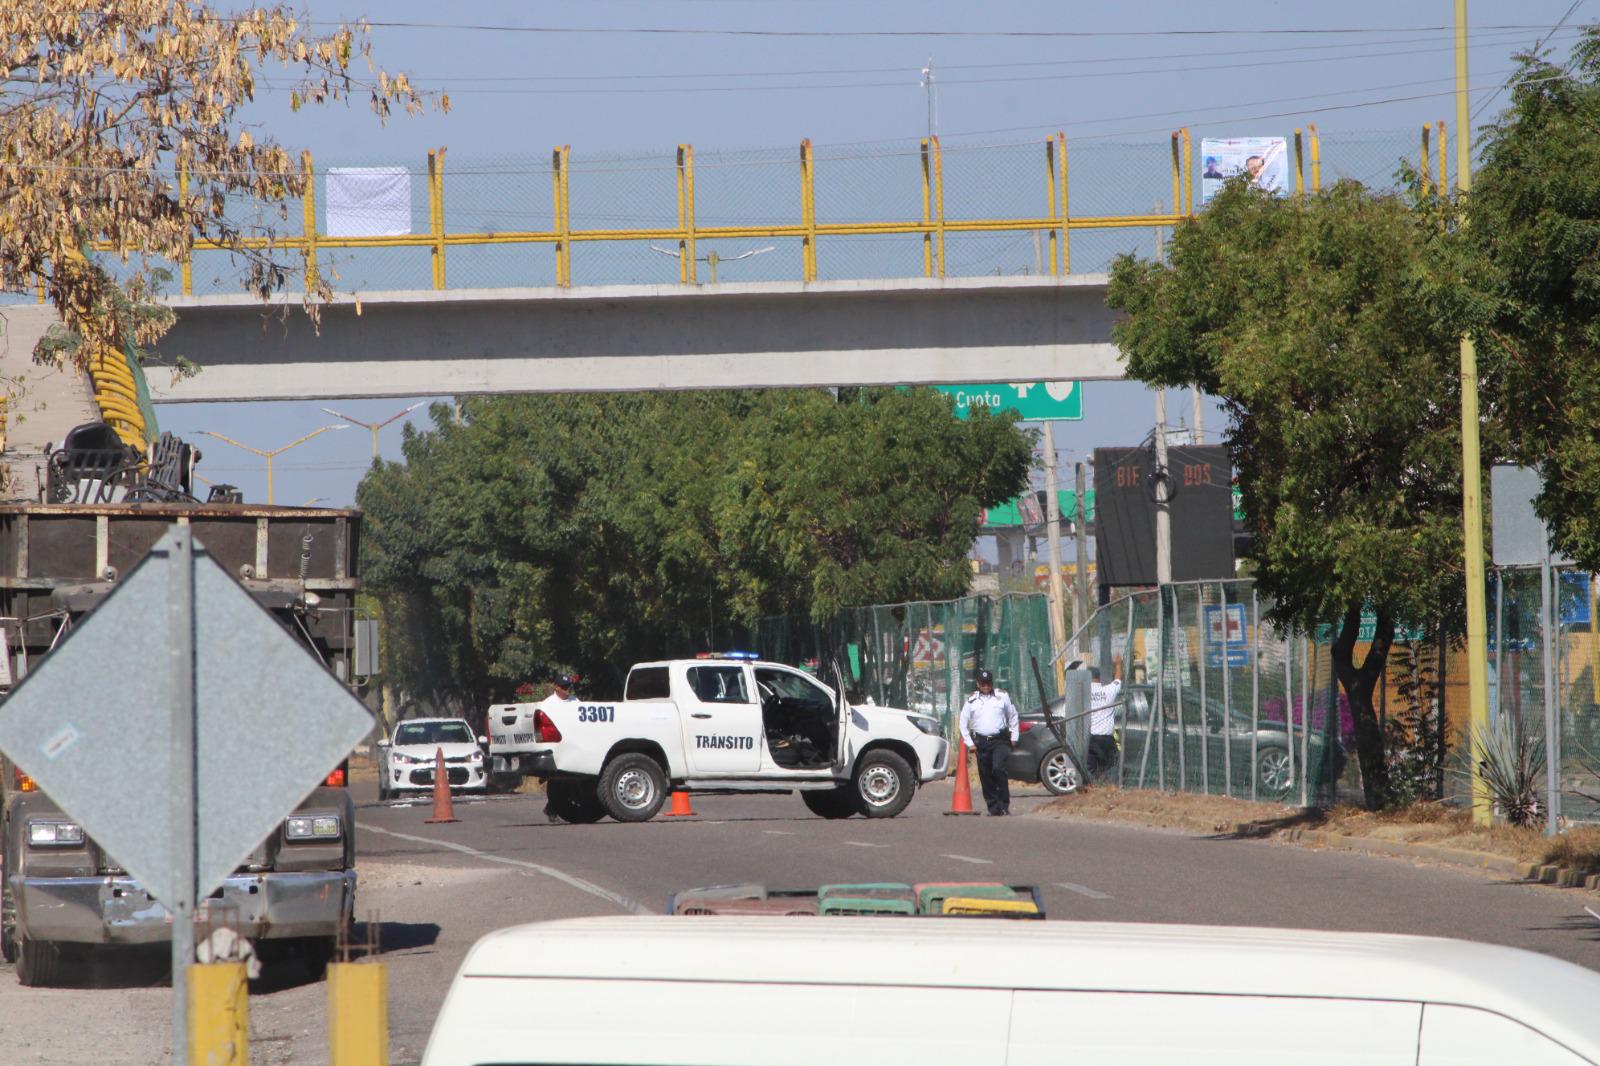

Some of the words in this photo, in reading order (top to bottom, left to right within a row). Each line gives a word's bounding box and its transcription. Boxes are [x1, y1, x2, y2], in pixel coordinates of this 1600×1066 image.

[956, 391, 1000, 408] Cuota
[578, 706, 614, 722] 3307
[695, 733, 753, 750] TRÁNSITO
